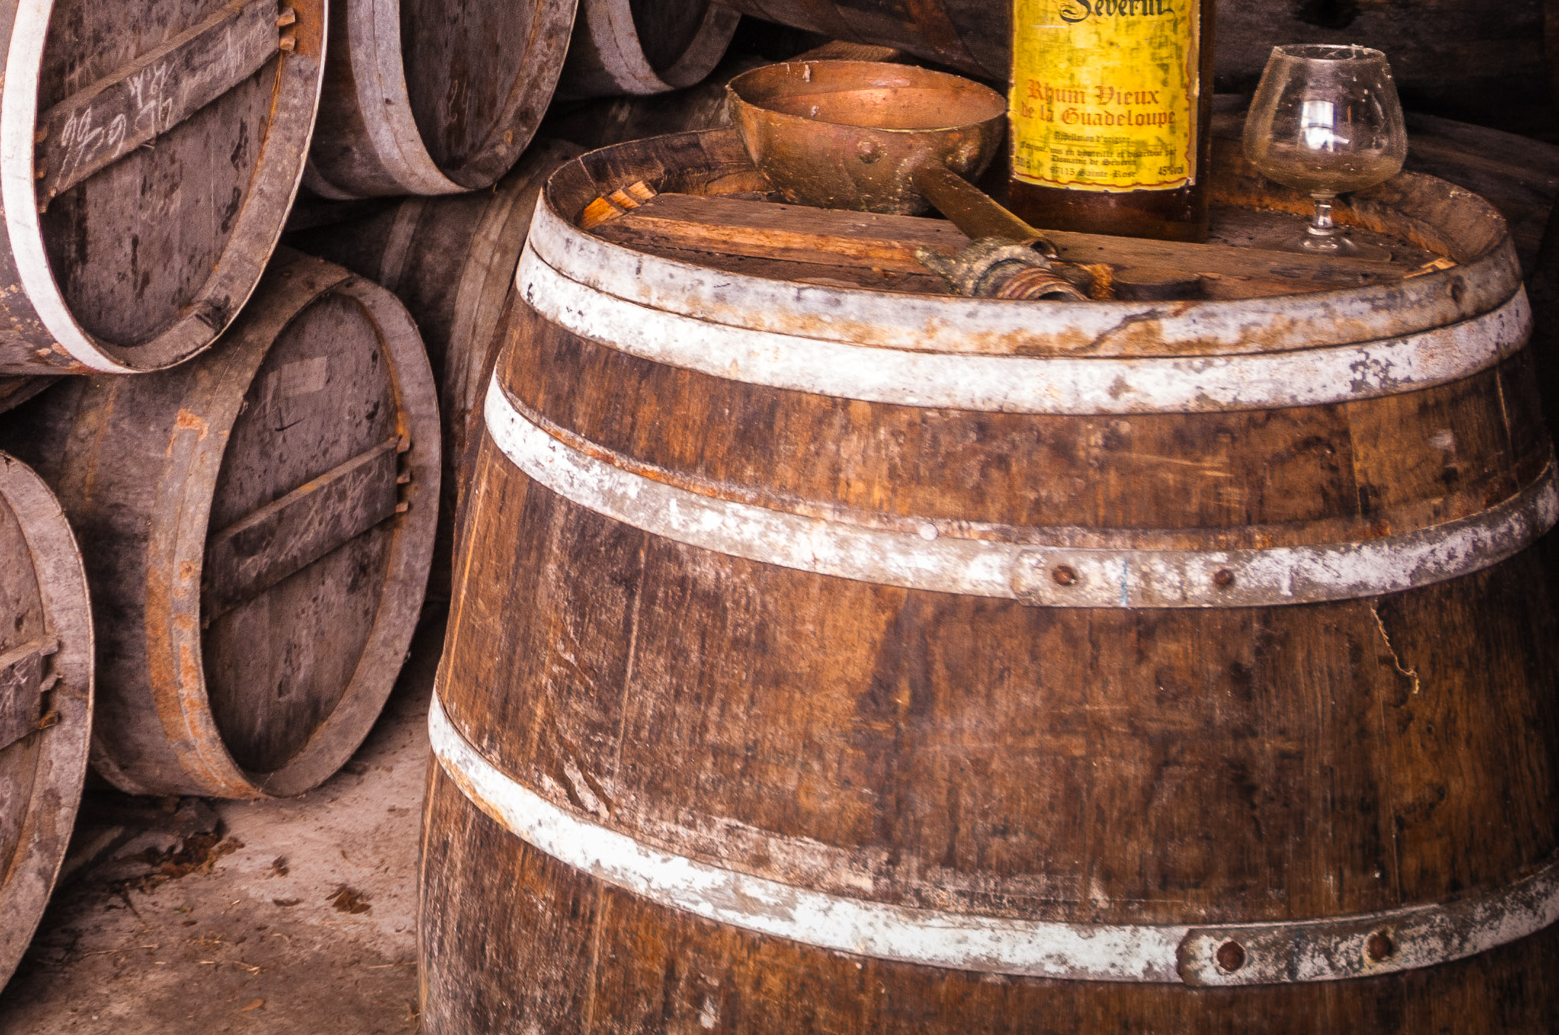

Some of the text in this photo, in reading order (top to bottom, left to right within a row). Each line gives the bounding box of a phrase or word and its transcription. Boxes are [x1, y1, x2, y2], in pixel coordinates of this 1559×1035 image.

[1028, 79, 1159, 106] Rhum Vieux
[1021, 101, 1176, 129] de la Guadeloupe
